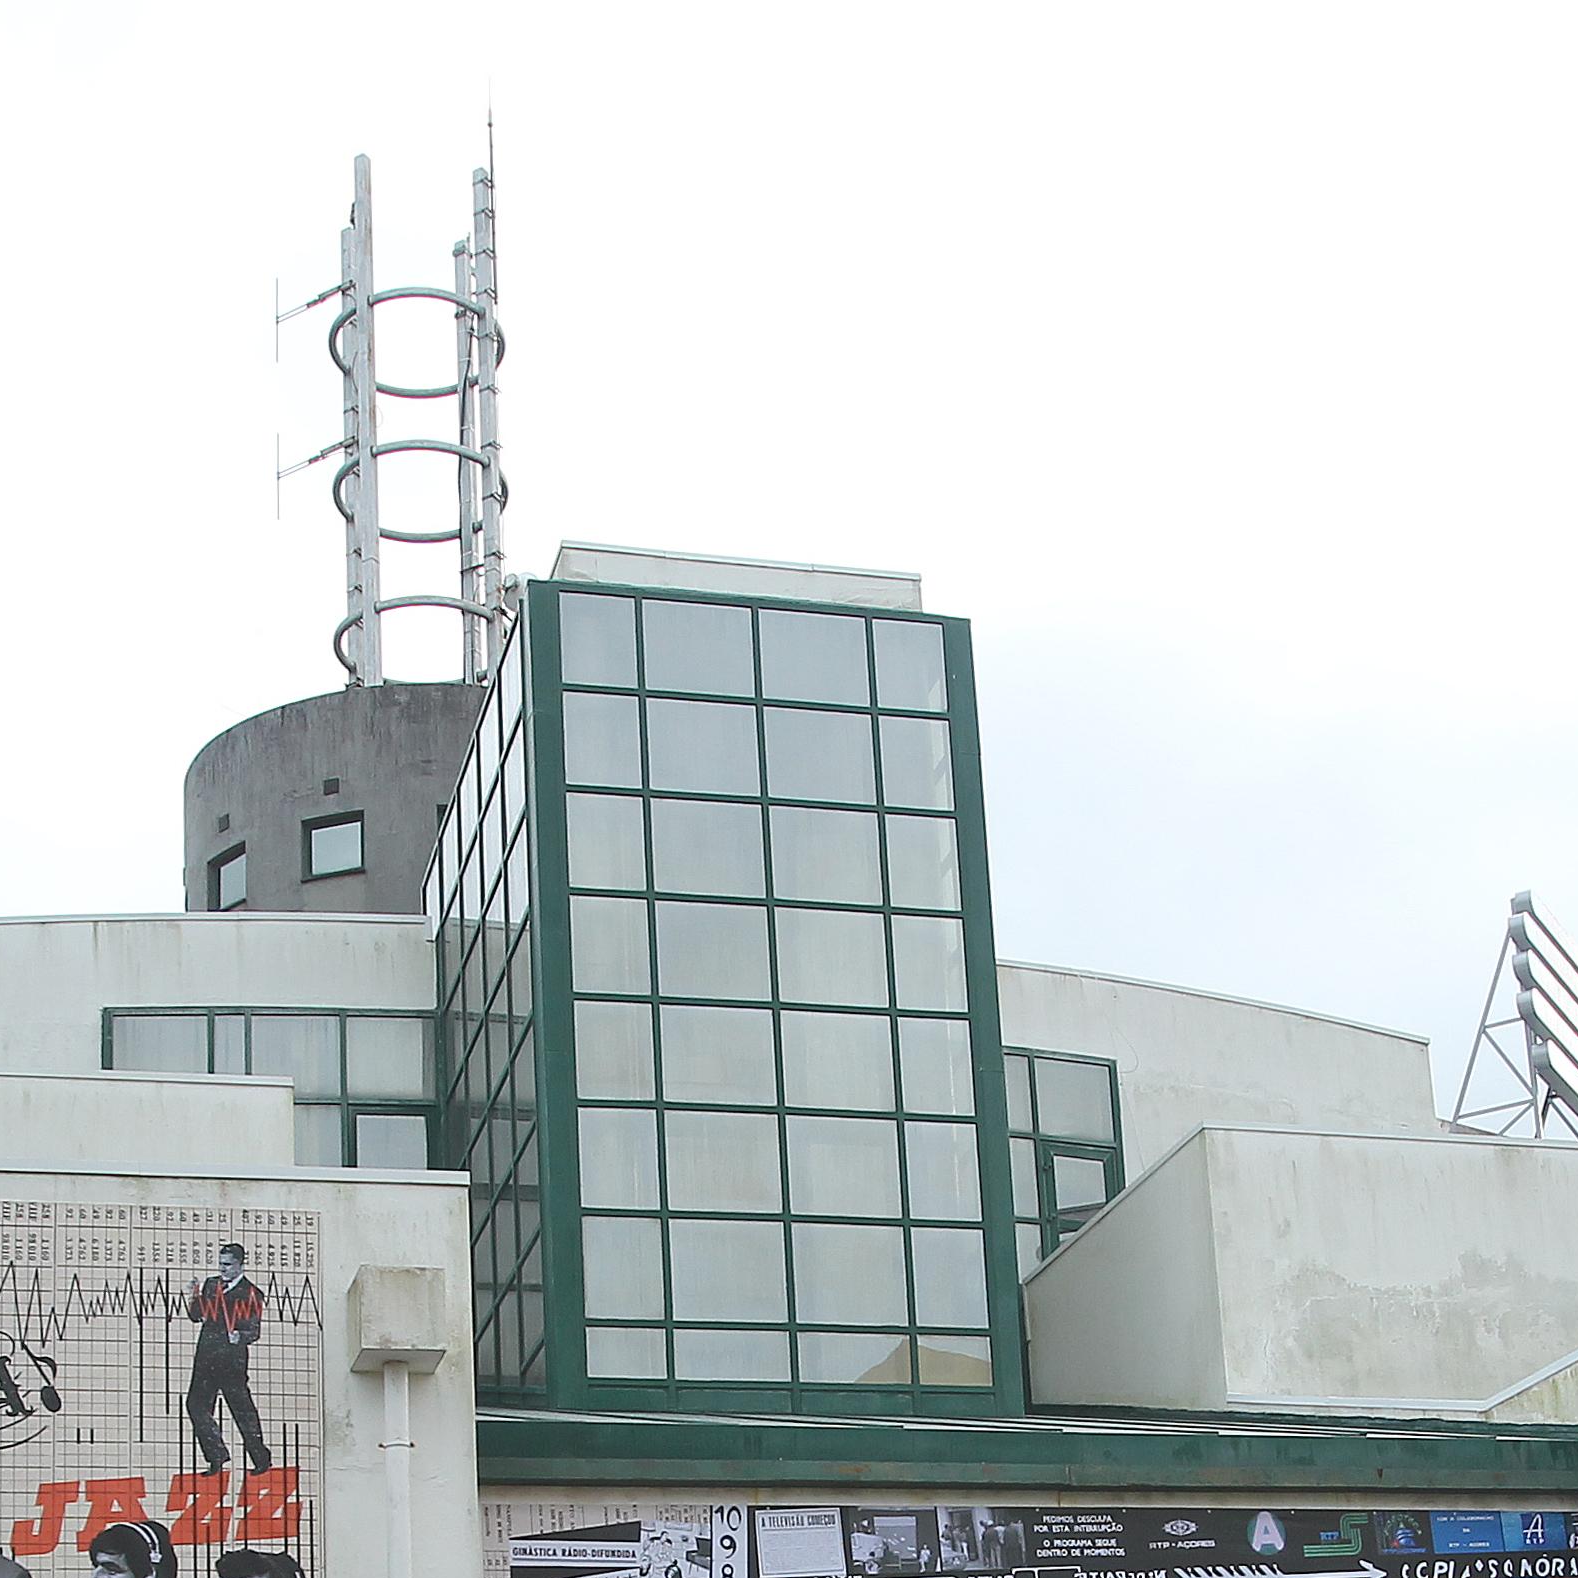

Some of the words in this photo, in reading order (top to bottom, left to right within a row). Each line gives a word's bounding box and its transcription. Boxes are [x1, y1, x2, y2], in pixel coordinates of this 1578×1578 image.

[10, 1465, 305, 1557] JAZZ
[714, 1505, 742, 1531] 10
[719, 1534, 737, 1559] 9
